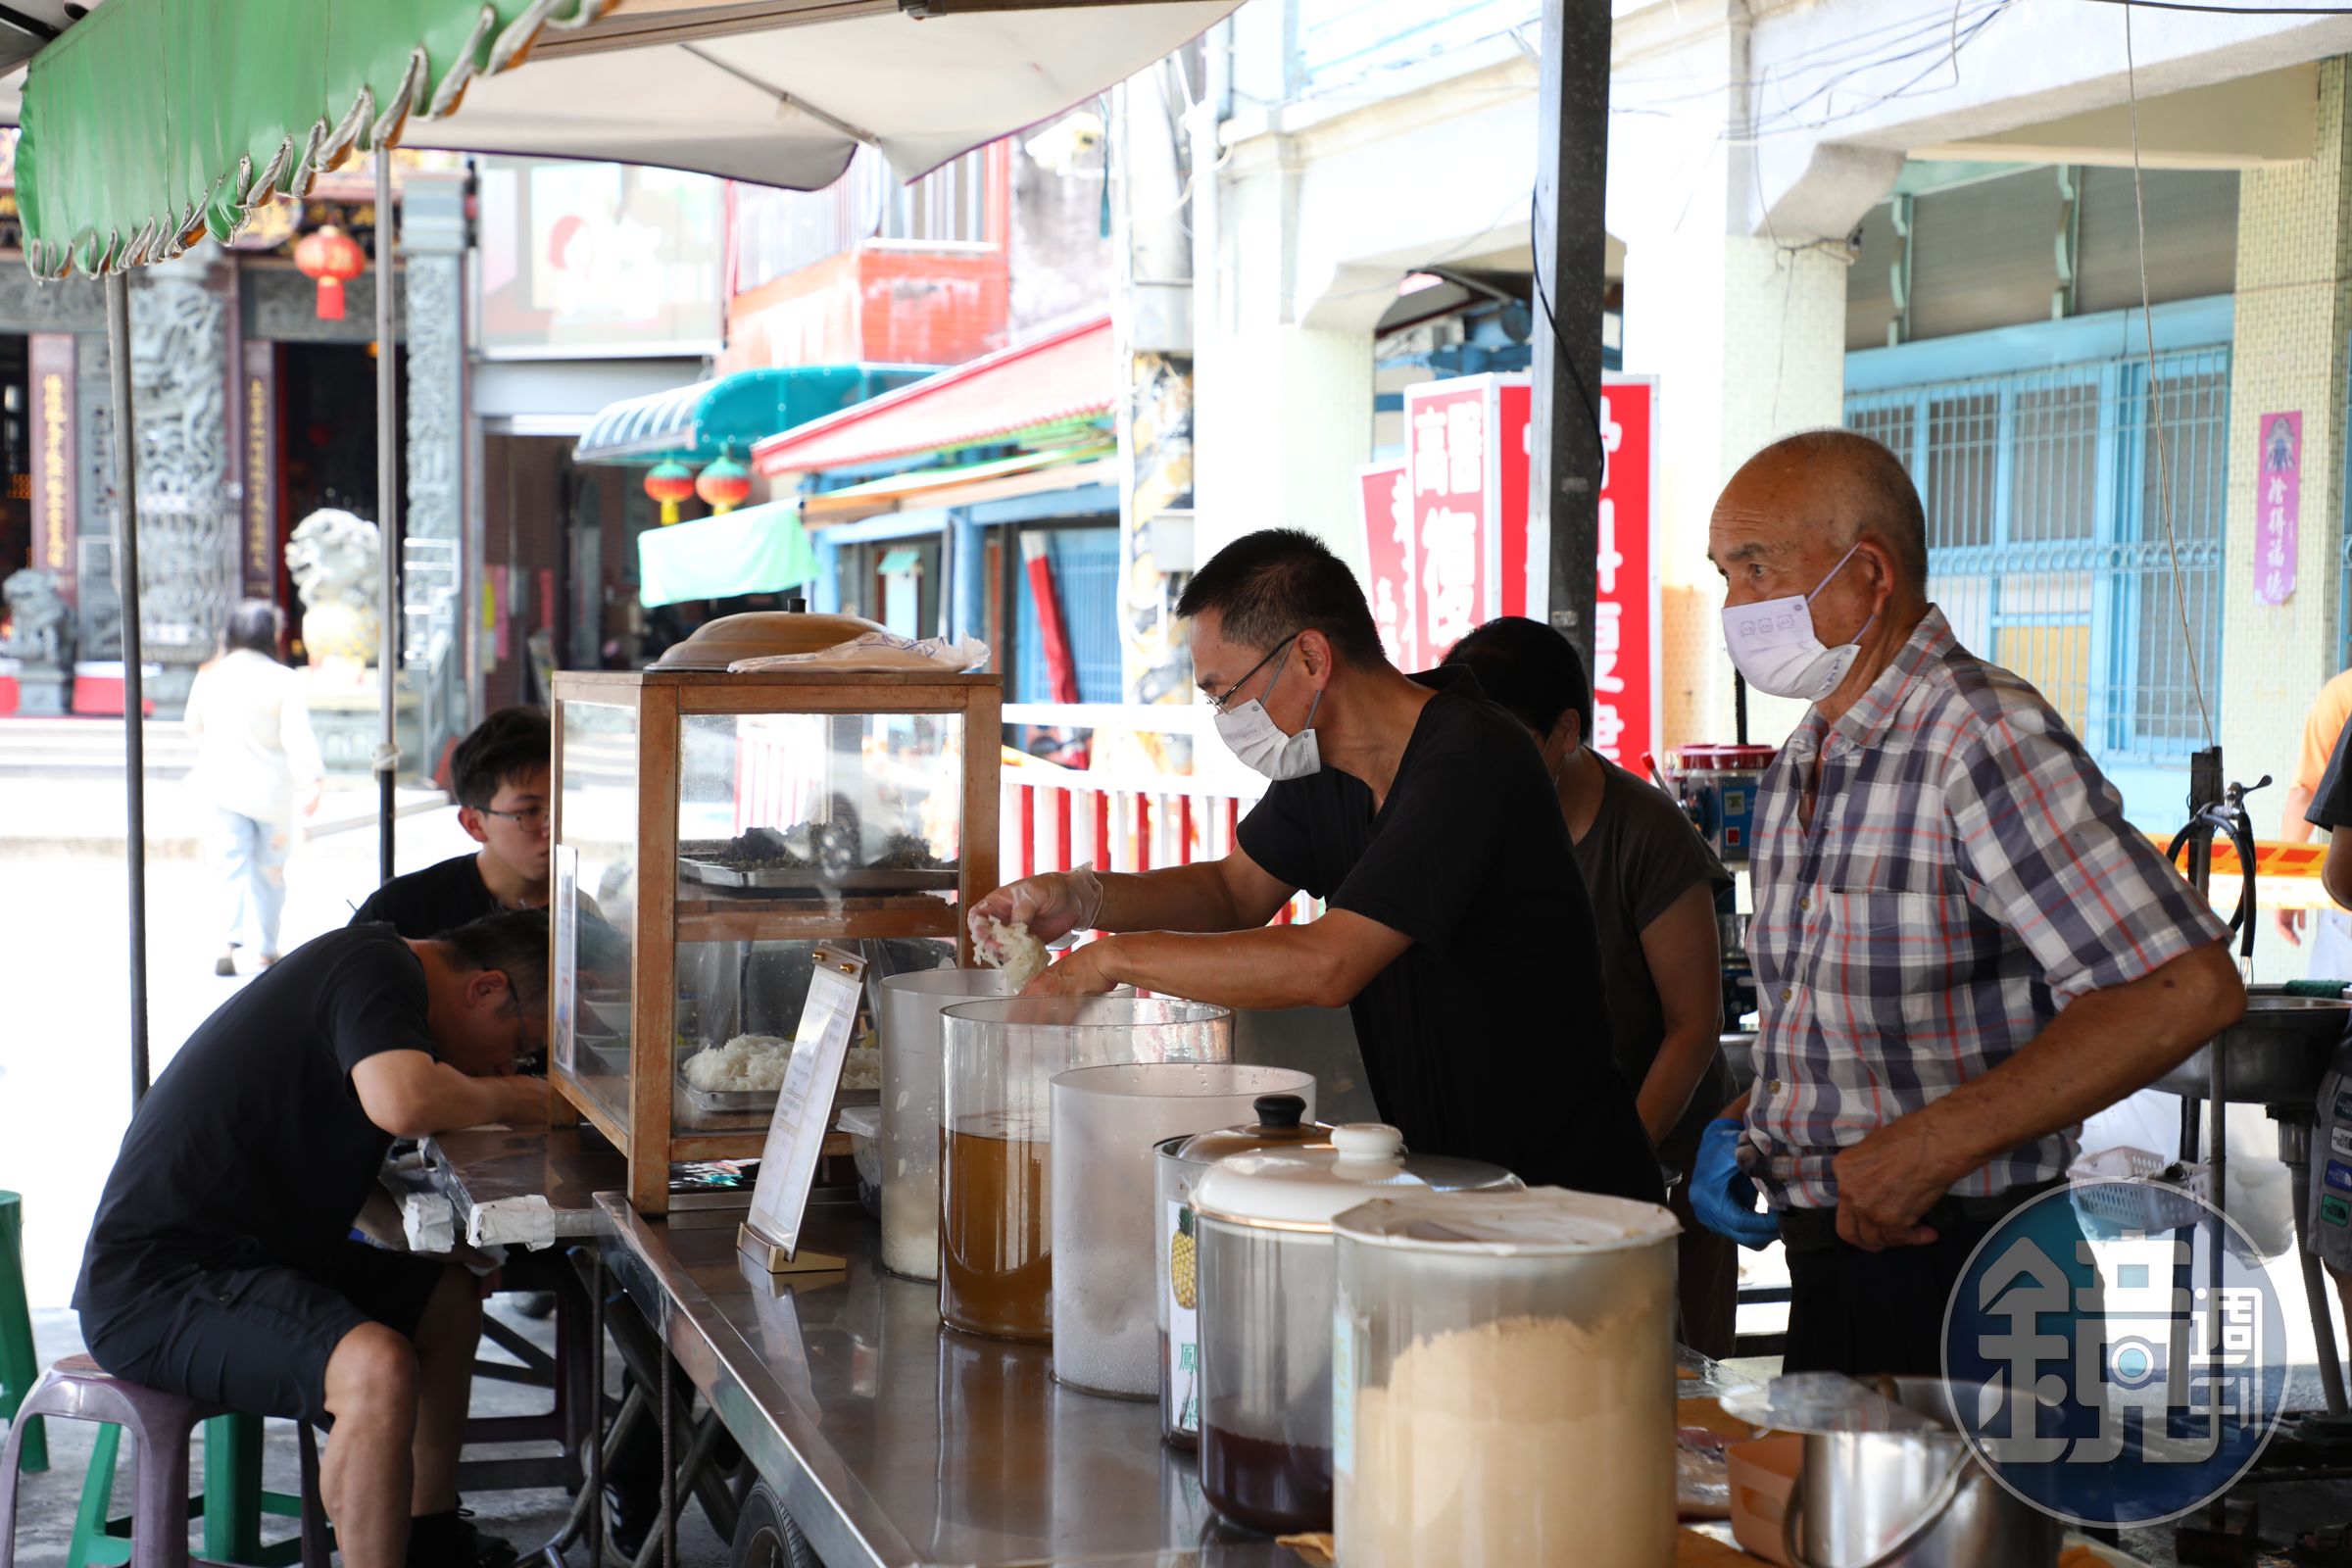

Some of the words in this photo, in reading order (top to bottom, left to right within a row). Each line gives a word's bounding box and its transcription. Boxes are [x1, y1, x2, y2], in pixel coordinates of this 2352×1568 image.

[1413, 401, 1483, 497] 高醫
[1421, 506, 1477, 664] 復
[1178, 1343, 1199, 1430] 鳳梨
